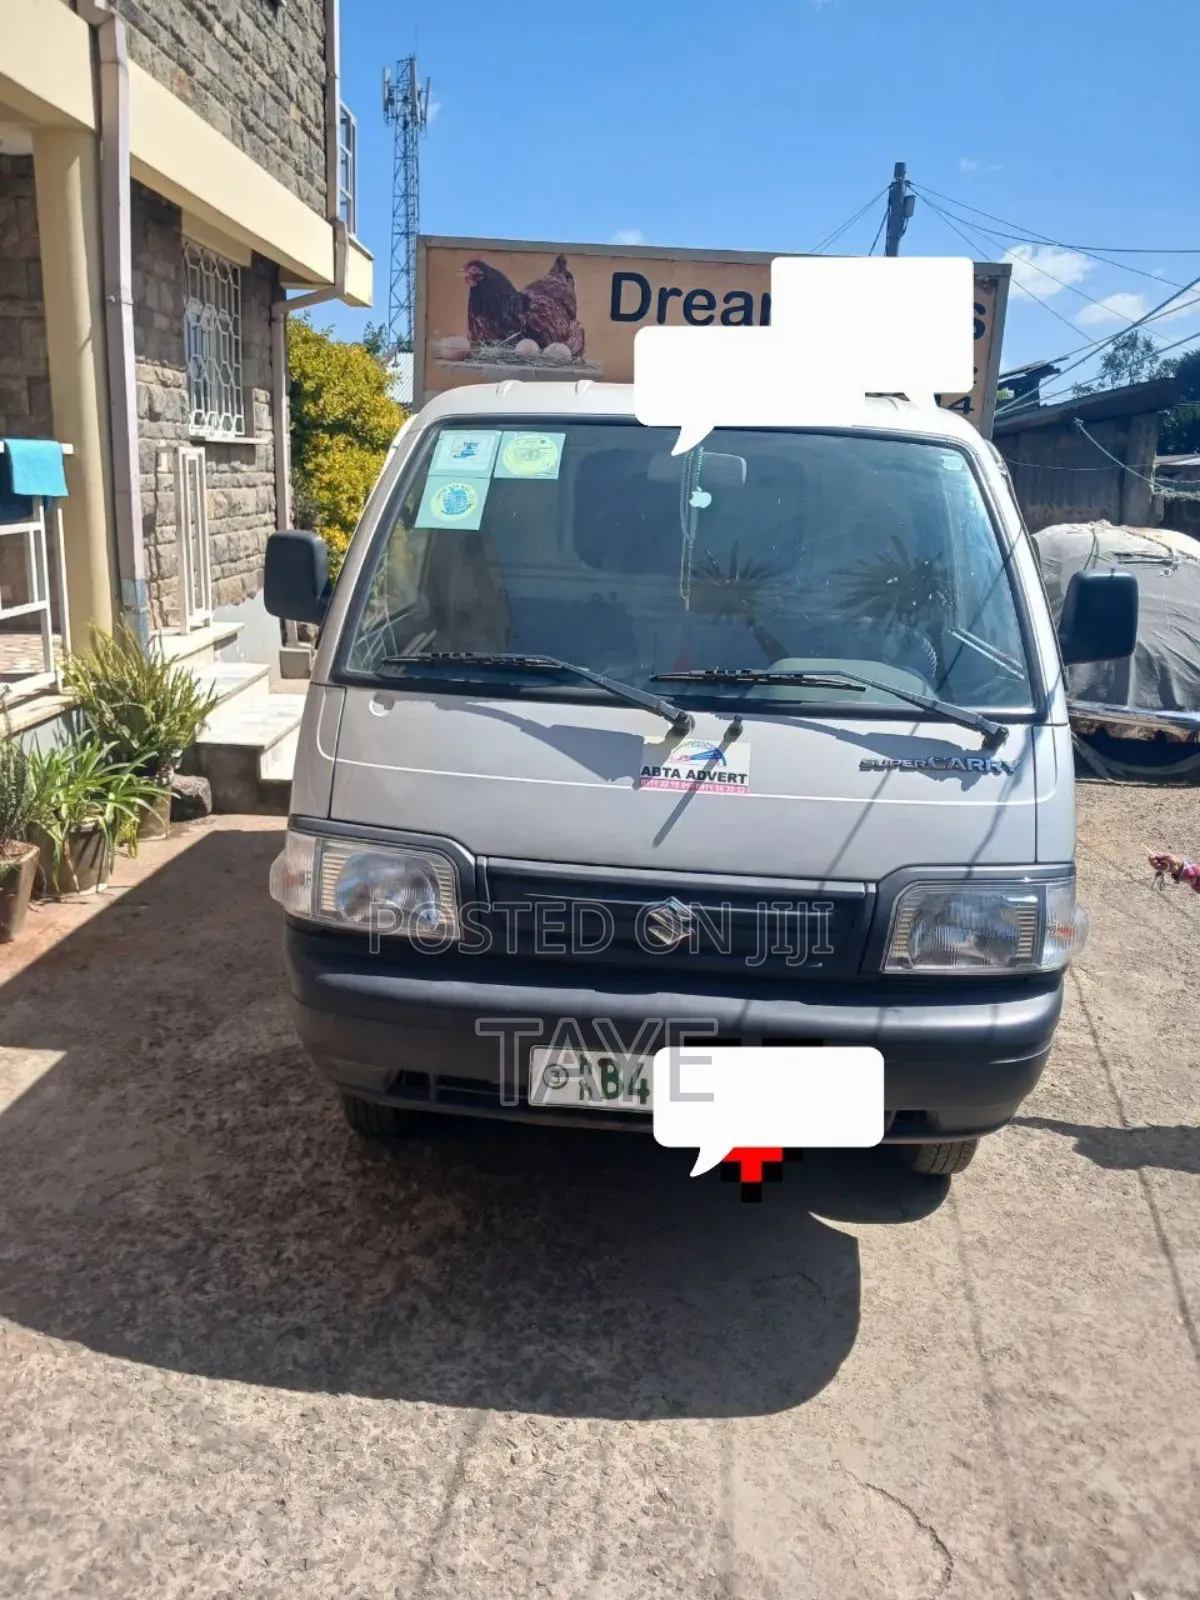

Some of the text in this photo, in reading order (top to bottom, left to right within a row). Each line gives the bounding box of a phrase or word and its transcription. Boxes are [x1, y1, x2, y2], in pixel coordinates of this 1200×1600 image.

[610, 272, 772, 327] Drea
[640, 765, 749, 785] ABTA ADVERT
